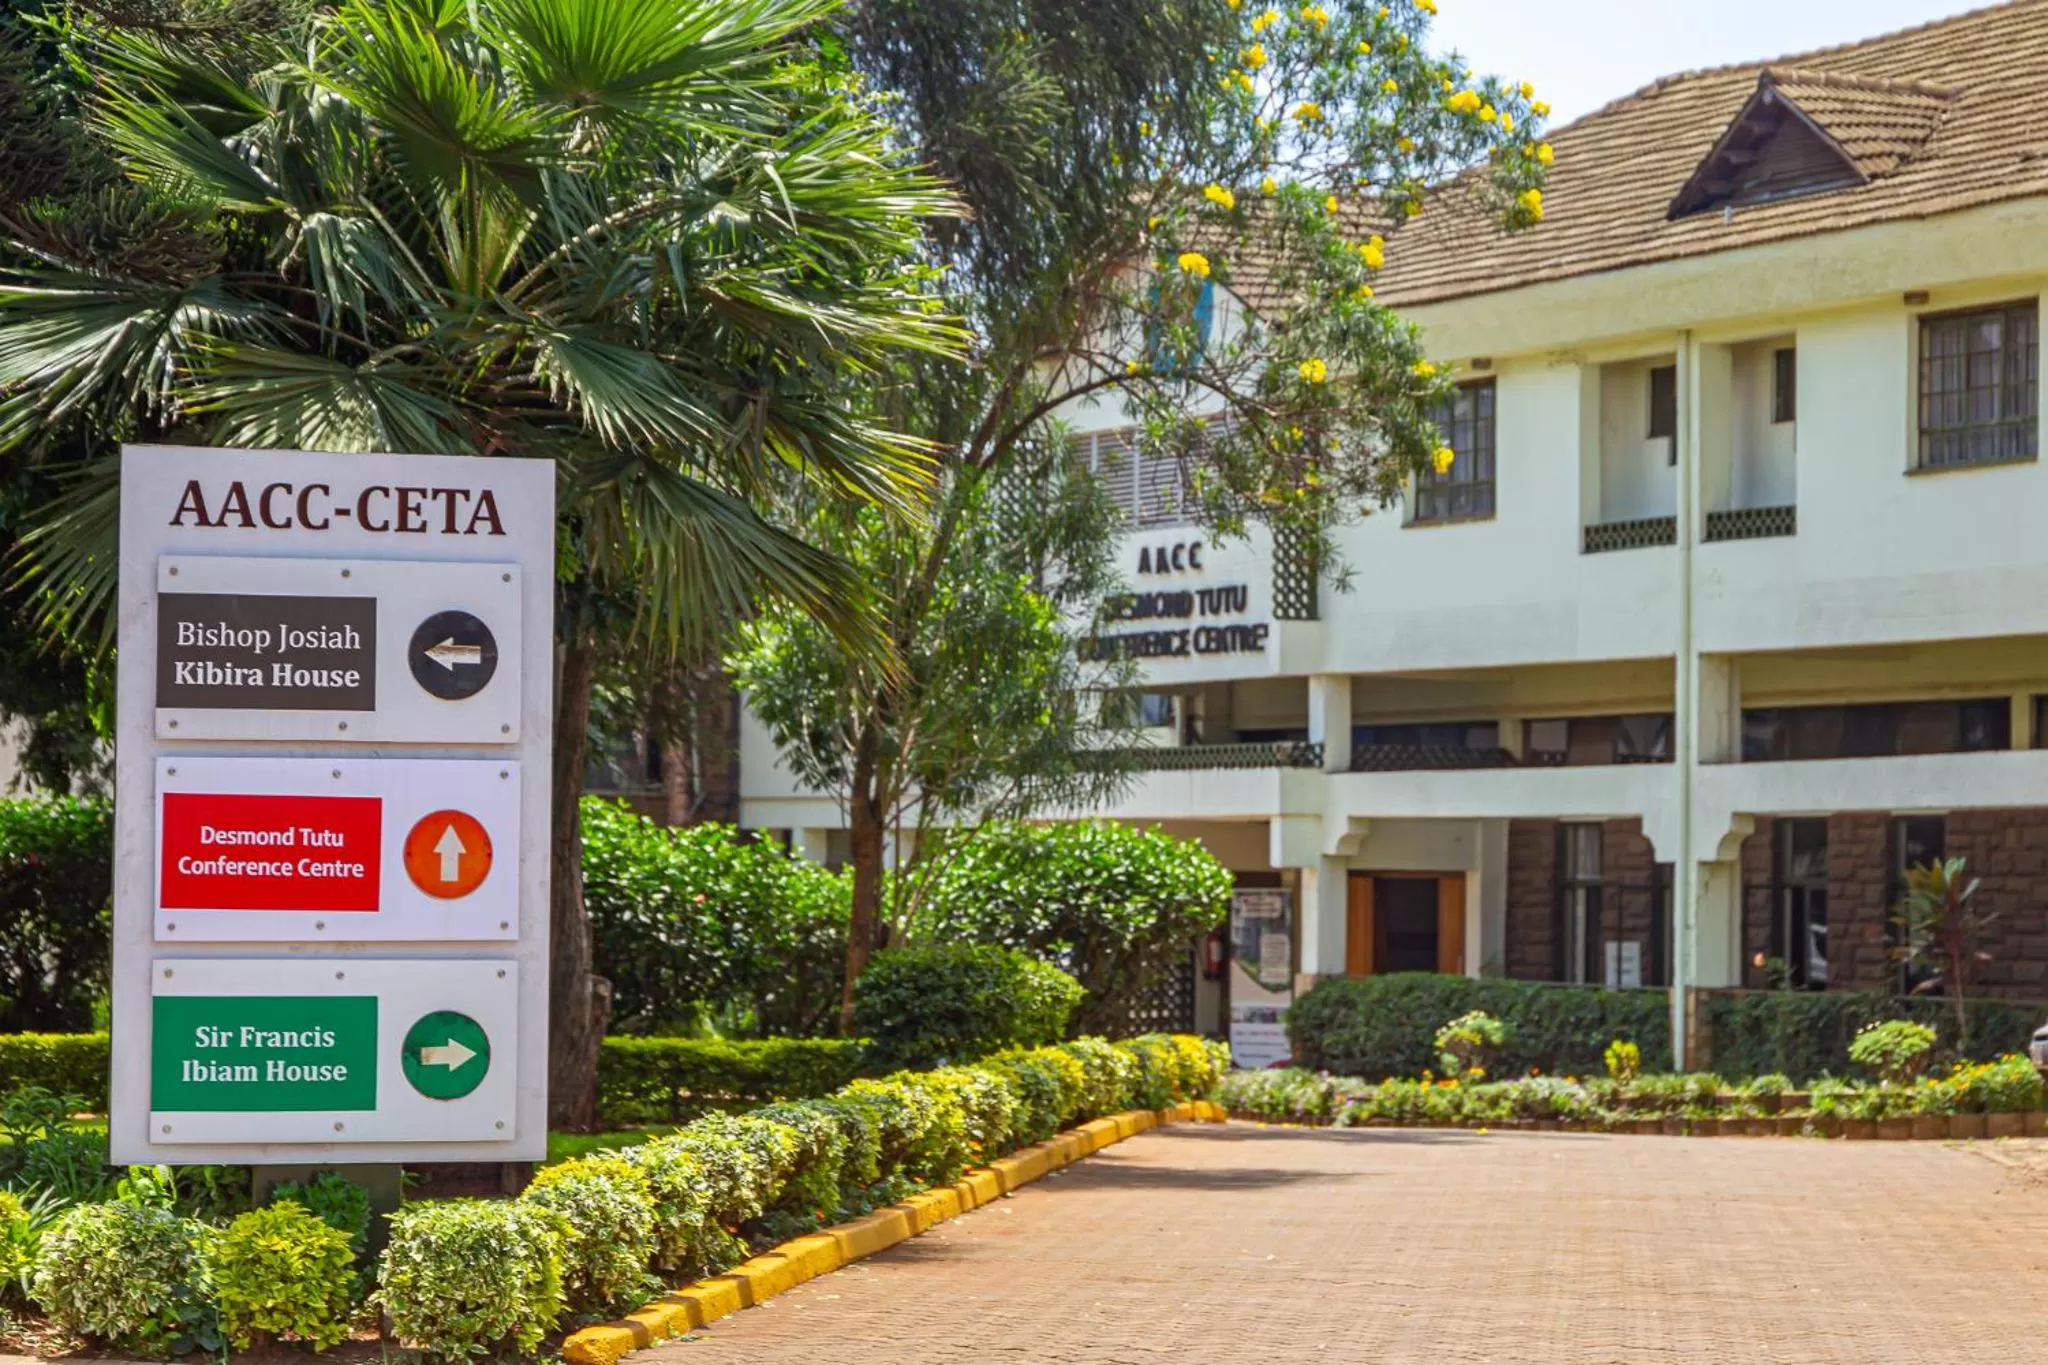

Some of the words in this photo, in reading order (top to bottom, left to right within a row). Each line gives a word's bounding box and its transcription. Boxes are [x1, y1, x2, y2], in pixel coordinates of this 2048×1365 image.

[169, 480, 507, 536] AACC-CETA
[1138, 543, 1202, 574] AACC
[1196, 585, 1247, 616] TUTU
[176, 622, 270, 654] Bishop
[278, 624, 361, 653] Josiah
[174, 661, 264, 687] Kibira
[271, 664, 360, 688] House
[200, 826, 295, 847] Desmond
[299, 829, 344, 848] Tutu
[178, 856, 293, 877] Conference
[298, 859, 364, 878] Centre
[195, 1026, 233, 1049] Sir
[239, 1026, 335, 1049] Francis
[181, 1060, 258, 1083] Ibiam
[266, 1060, 348, 1082] House
